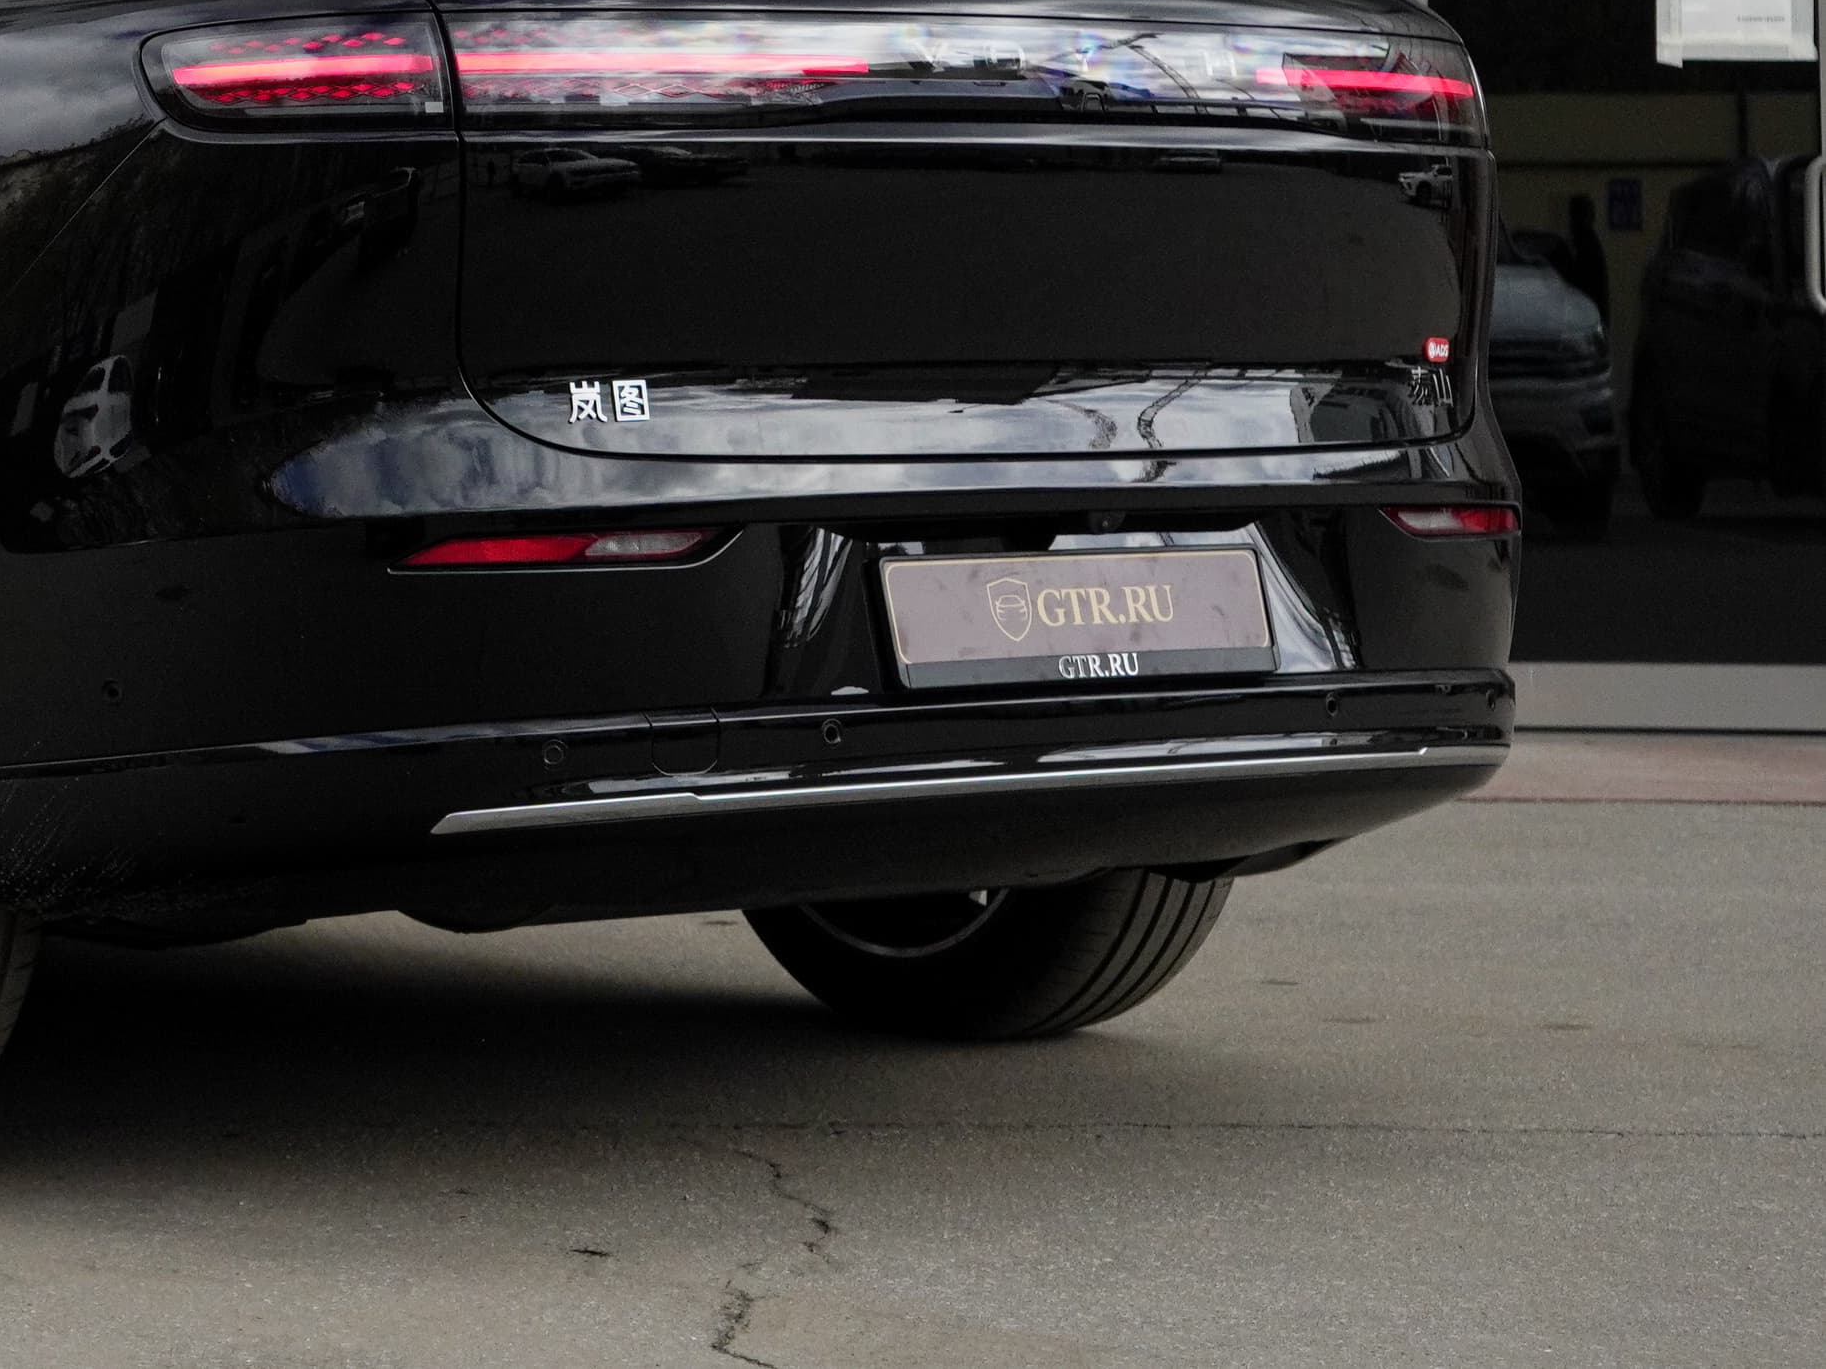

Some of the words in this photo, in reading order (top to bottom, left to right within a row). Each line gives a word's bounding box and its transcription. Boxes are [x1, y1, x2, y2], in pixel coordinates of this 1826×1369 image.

[568, 378, 651, 424] 岚图
[1037, 583, 1175, 628] GTR.RU
[1057, 652, 1140, 681] GTR.RU
